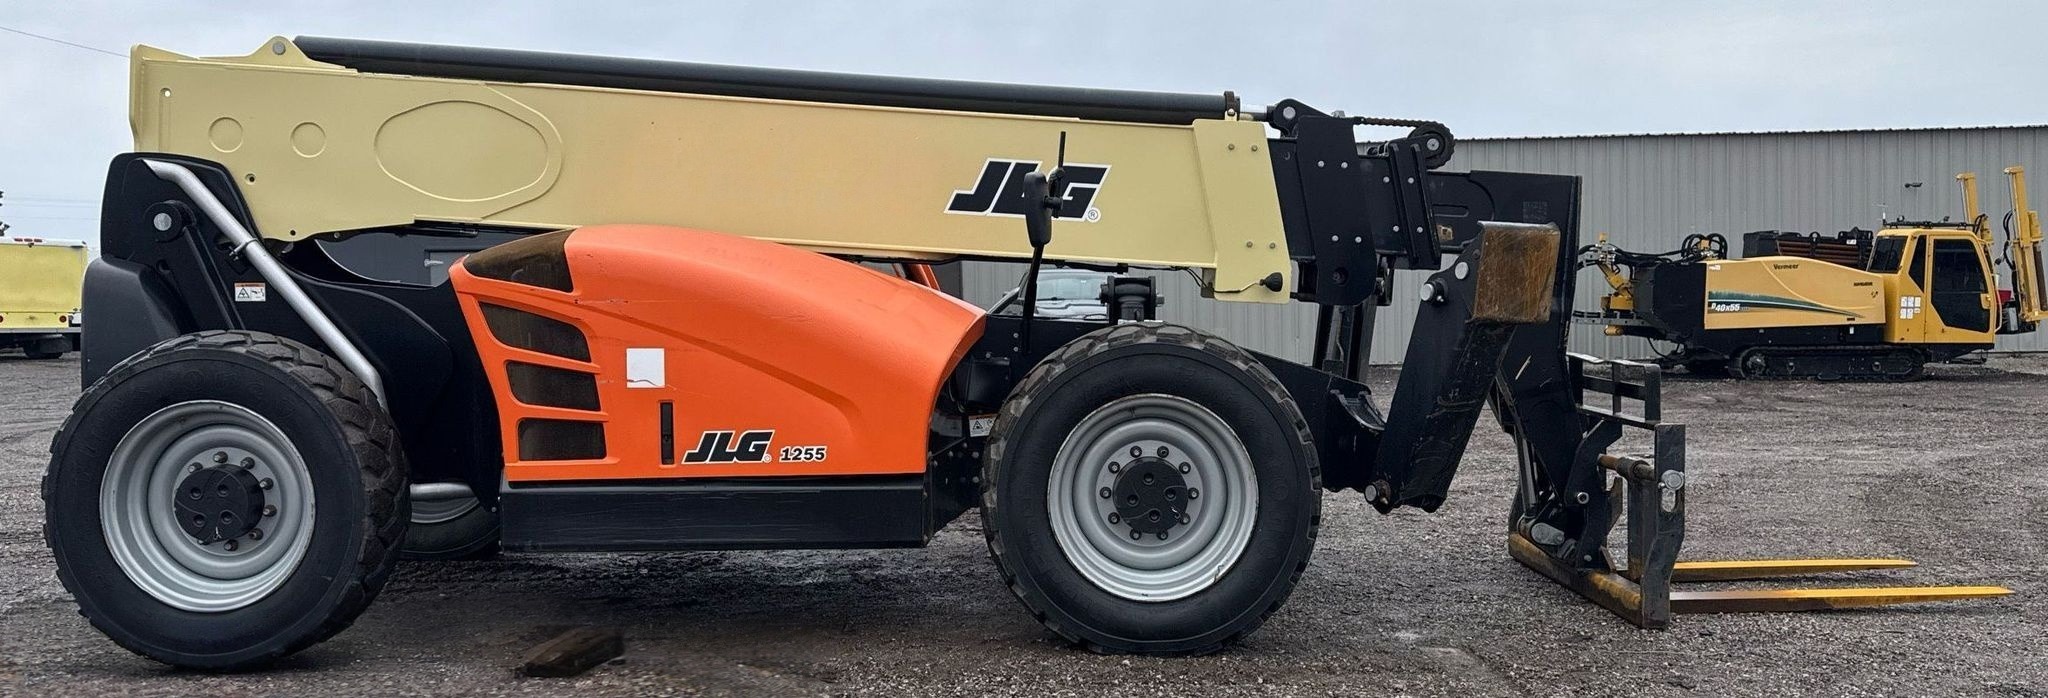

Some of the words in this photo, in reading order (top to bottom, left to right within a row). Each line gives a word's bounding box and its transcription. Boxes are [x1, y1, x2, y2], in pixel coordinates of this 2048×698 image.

[946, 159, 1110, 220] JLG
[683, 431, 774, 463] JLG
[780, 447, 826, 461] 1255
